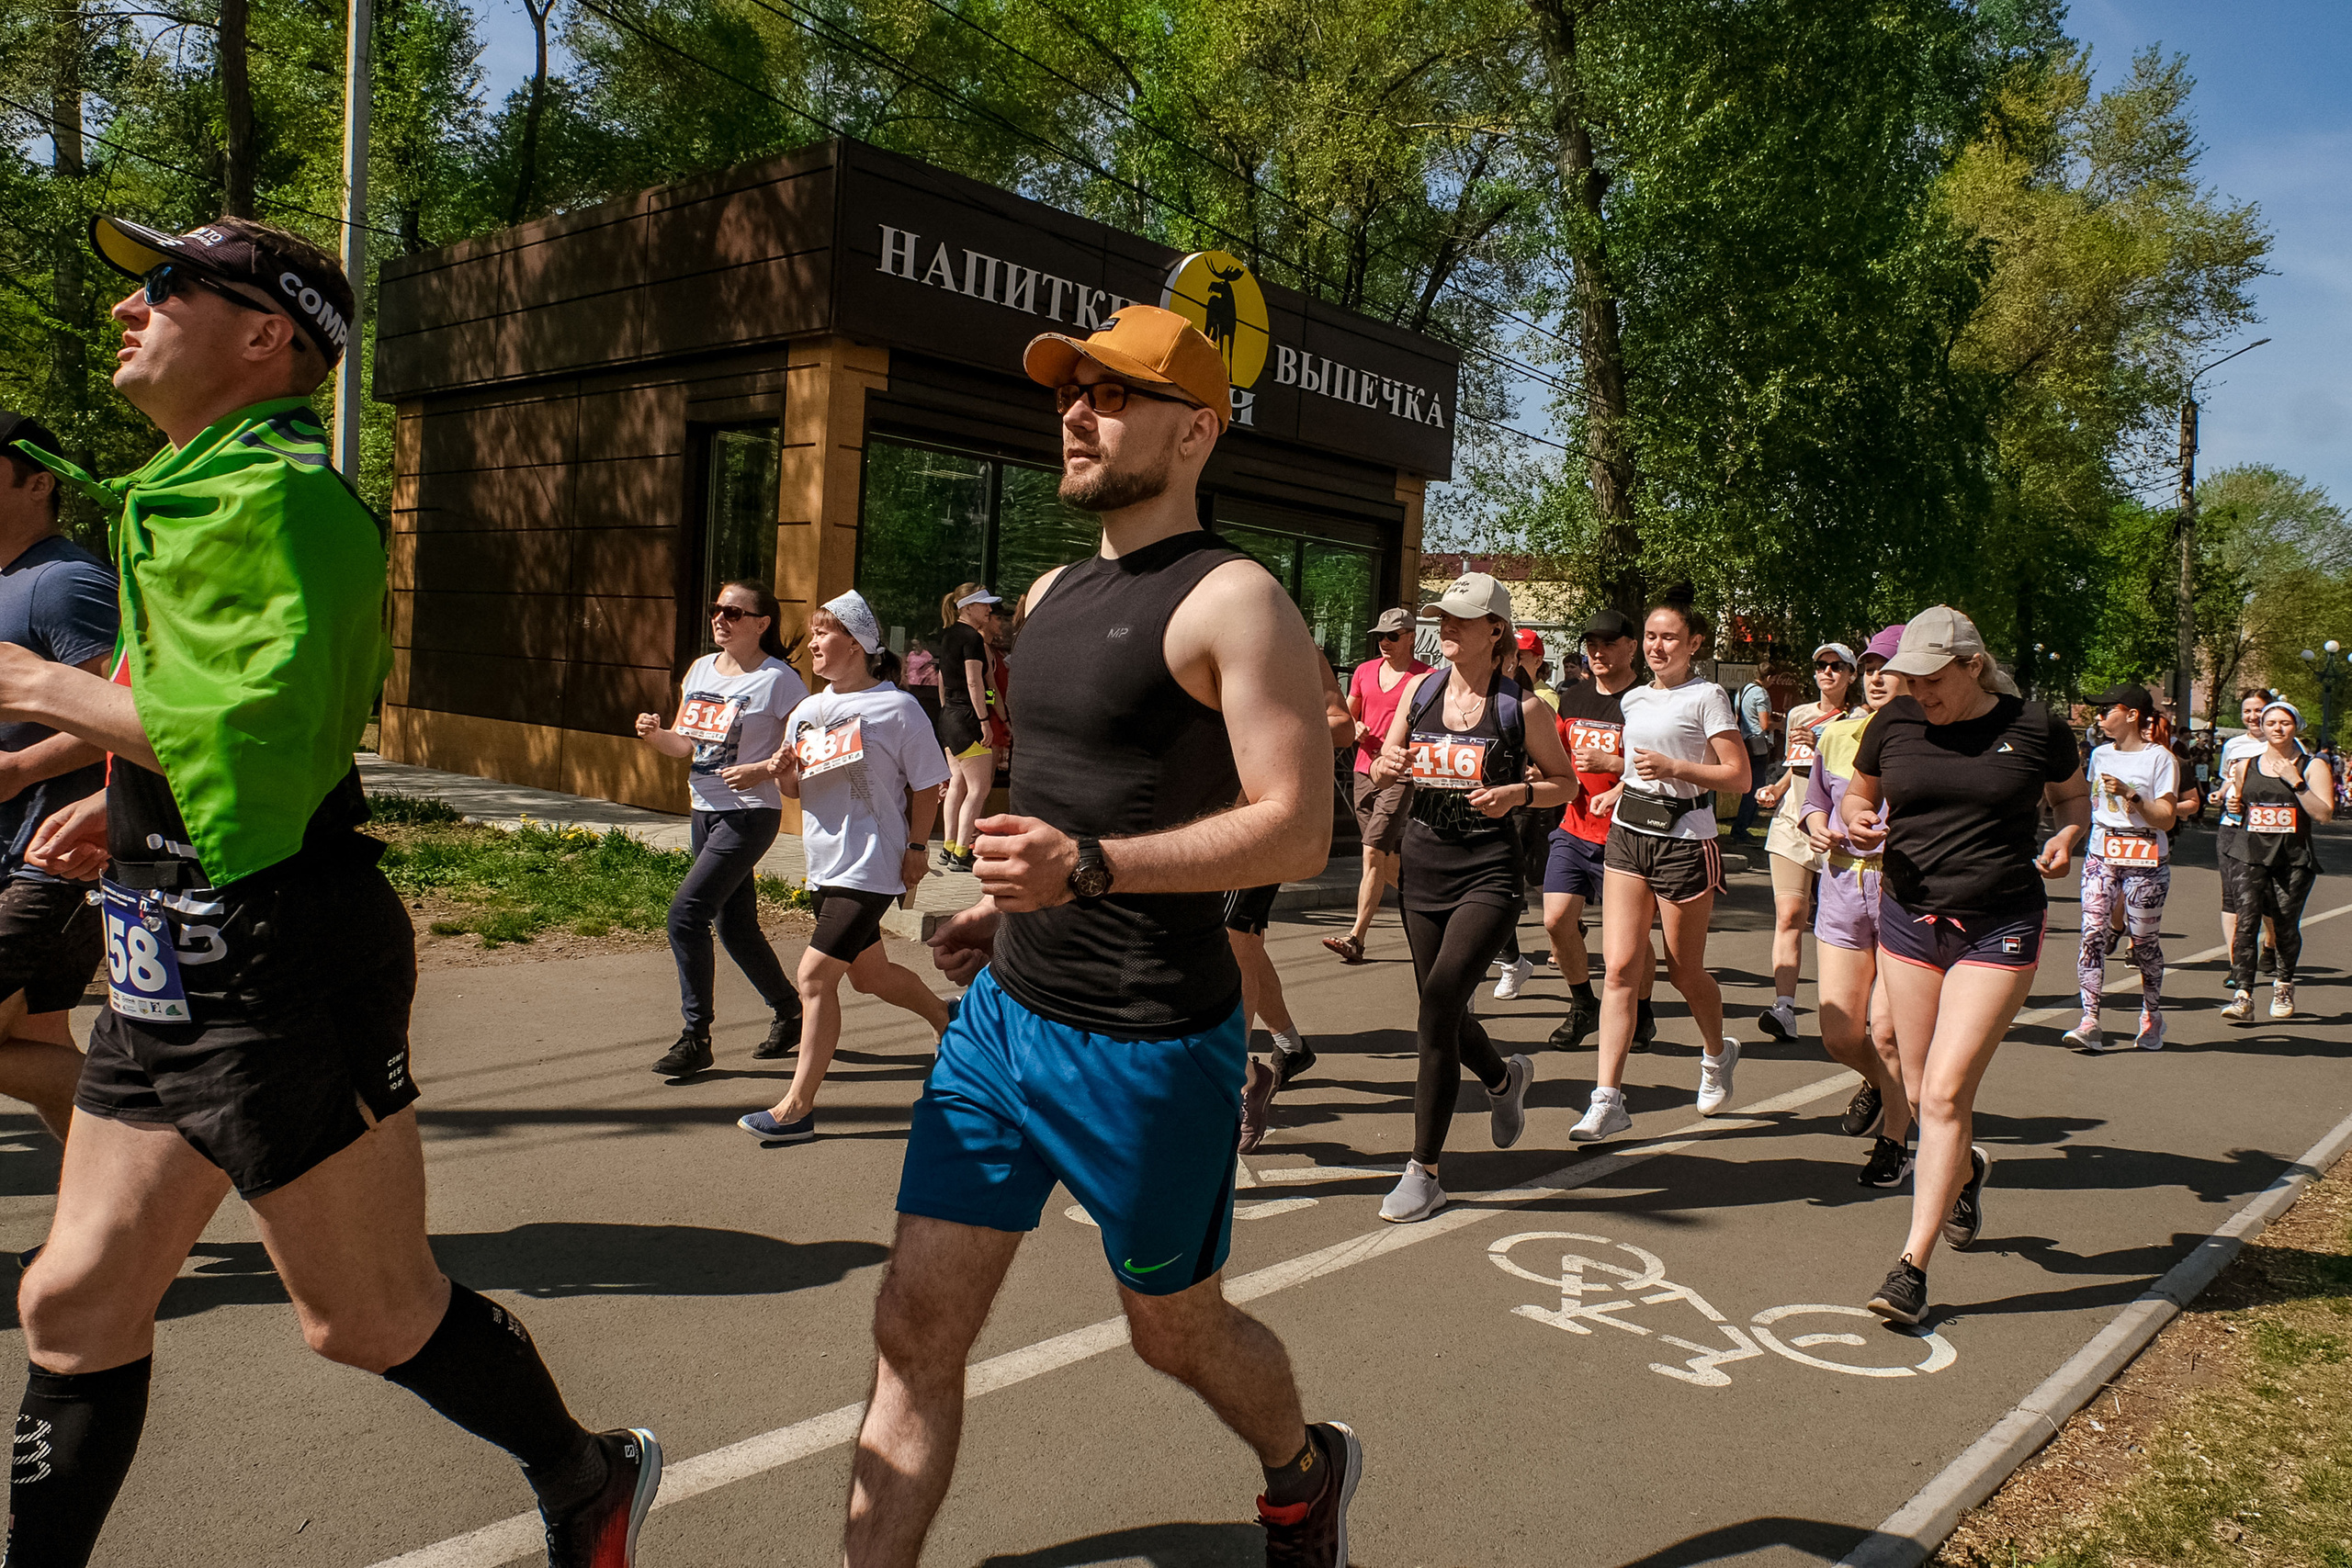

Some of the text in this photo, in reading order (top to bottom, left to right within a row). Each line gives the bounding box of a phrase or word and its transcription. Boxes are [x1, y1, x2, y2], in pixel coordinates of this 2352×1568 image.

[876, 223, 1141, 331] НАПИТК
[279, 272, 347, 357] COMP
[1273, 344, 1445, 429] ВЫПЕЧКА
[683, 703, 730, 731] 514
[1573, 728, 1616, 753] 733
[1789, 744, 1815, 759] 76
[1414, 746, 1476, 777] 416
[2250, 808, 2292, 826] 836
[2106, 838, 2153, 858] 677
[108, 914, 167, 993] 58
